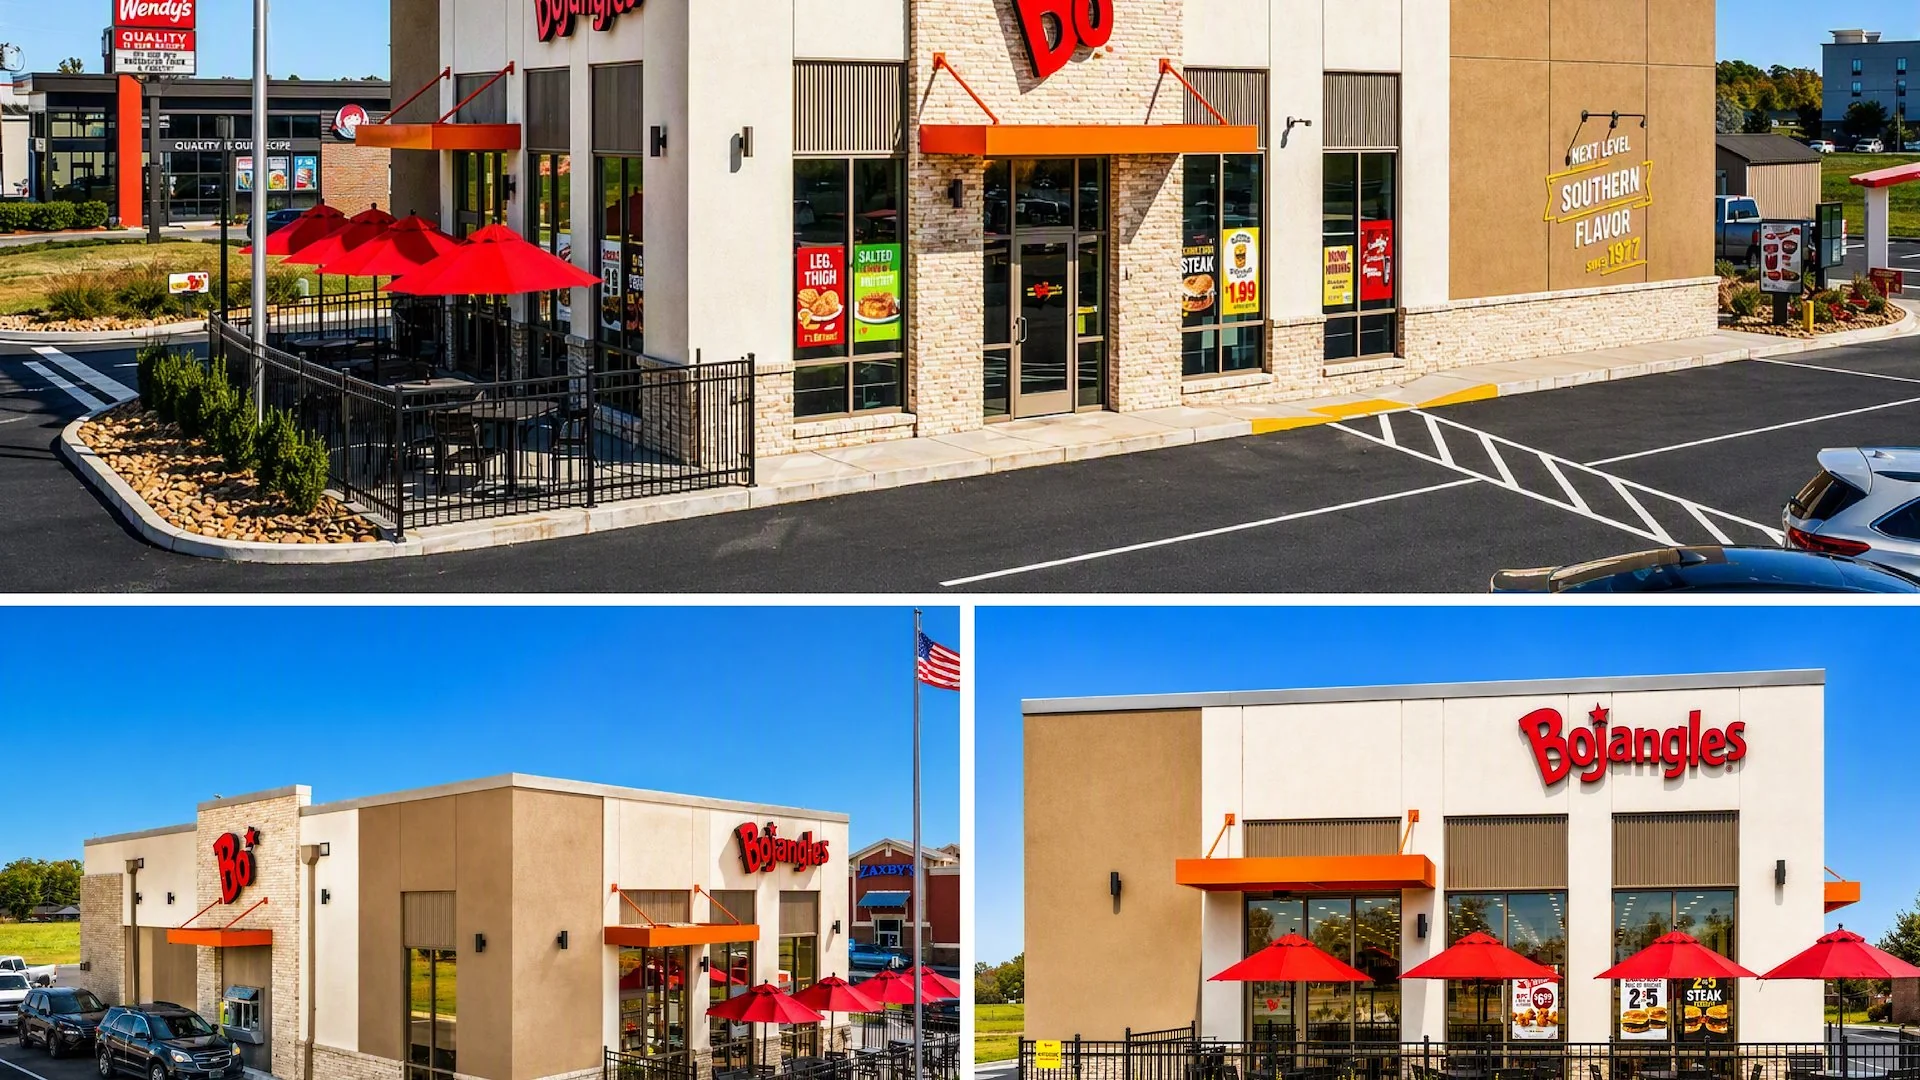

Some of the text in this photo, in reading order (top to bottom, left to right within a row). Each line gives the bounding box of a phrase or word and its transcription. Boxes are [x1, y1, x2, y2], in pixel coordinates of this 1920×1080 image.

[120, 0, 192, 22] Wendy's
[122, 31, 186, 43] QUALITY
[1571, 136, 1631, 164] NEXT LEVEL
[1561, 166, 1640, 212] SOUTHERN
[1575, 209, 1631, 249] FLAVOR
[859, 250, 893, 263] SALTED
[1608, 237, 1640, 266] 1977
[1182, 256, 1214, 274] STEAK
[805, 270, 837, 286] THIGH
[1518, 703, 1747, 785] Bojangles
[734, 822, 829, 874] Bojangles
[1687, 990, 1722, 1001] STEAK
